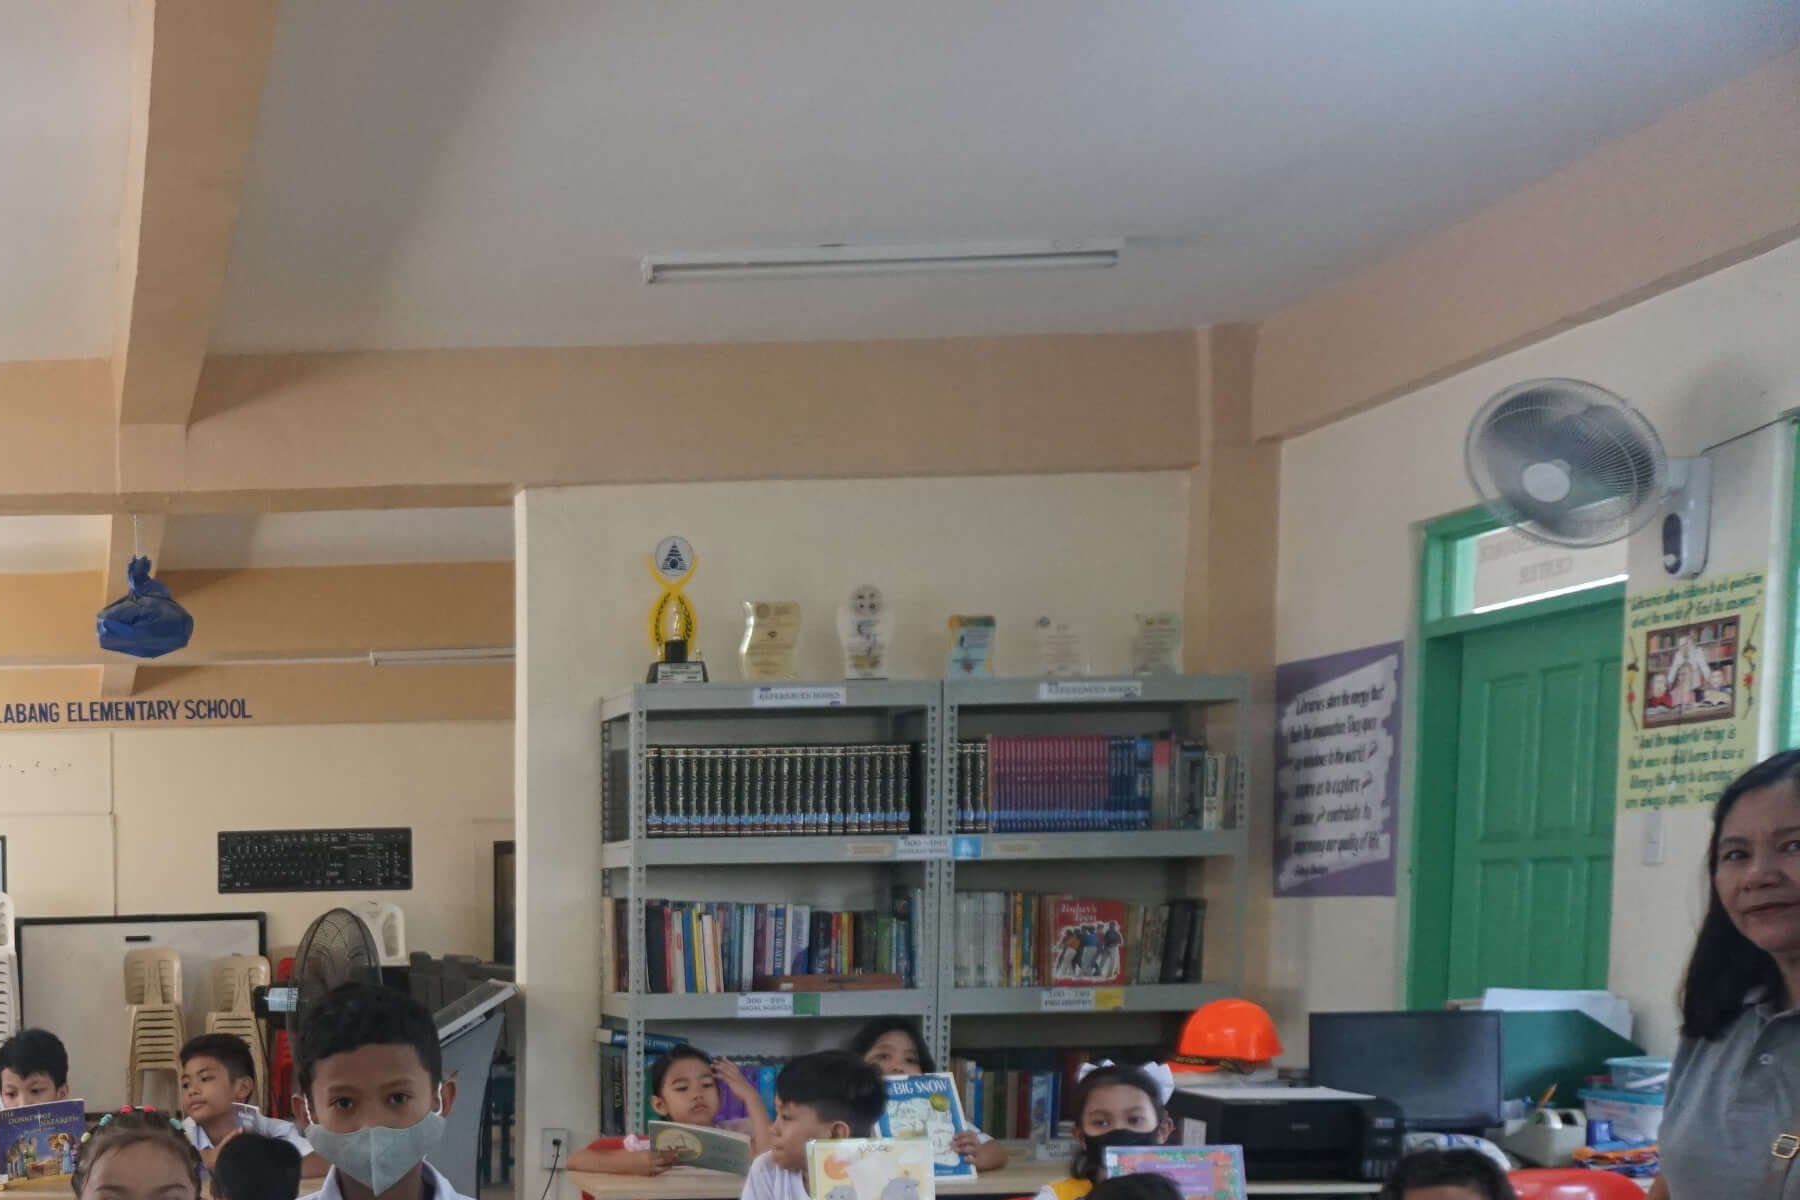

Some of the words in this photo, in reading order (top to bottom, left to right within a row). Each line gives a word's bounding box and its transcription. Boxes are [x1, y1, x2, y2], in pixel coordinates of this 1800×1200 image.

[67, 700, 179, 723] ELEMENTARY
[184, 698, 253, 719] SCHOOL
[893, 1081, 914, 1095] BIG
[914, 1079, 947, 1093] SNOW
